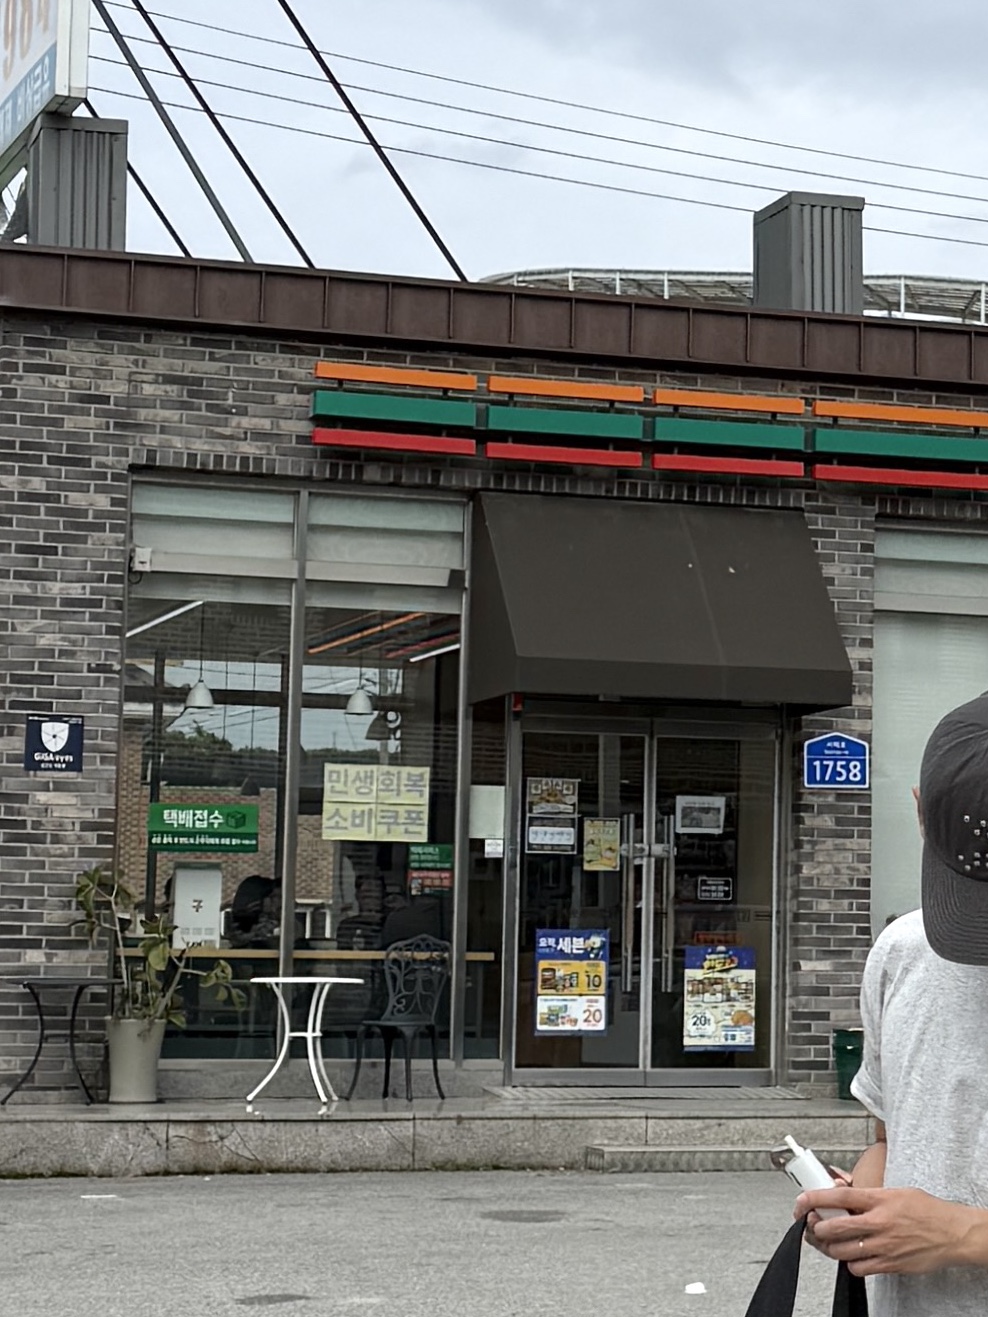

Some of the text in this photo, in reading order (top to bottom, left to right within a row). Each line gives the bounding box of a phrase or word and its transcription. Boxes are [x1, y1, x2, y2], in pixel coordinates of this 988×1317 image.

[813, 760, 862, 782] 1758
[327, 768, 427, 798] 민생회복
[163, 810, 225, 829] 택배접수
[324, 807, 426, 835] 소비쿠폰
[557, 936, 585, 954] 세븐
[585, 974, 602, 988] 10
[583, 1008, 602, 1024] 20
